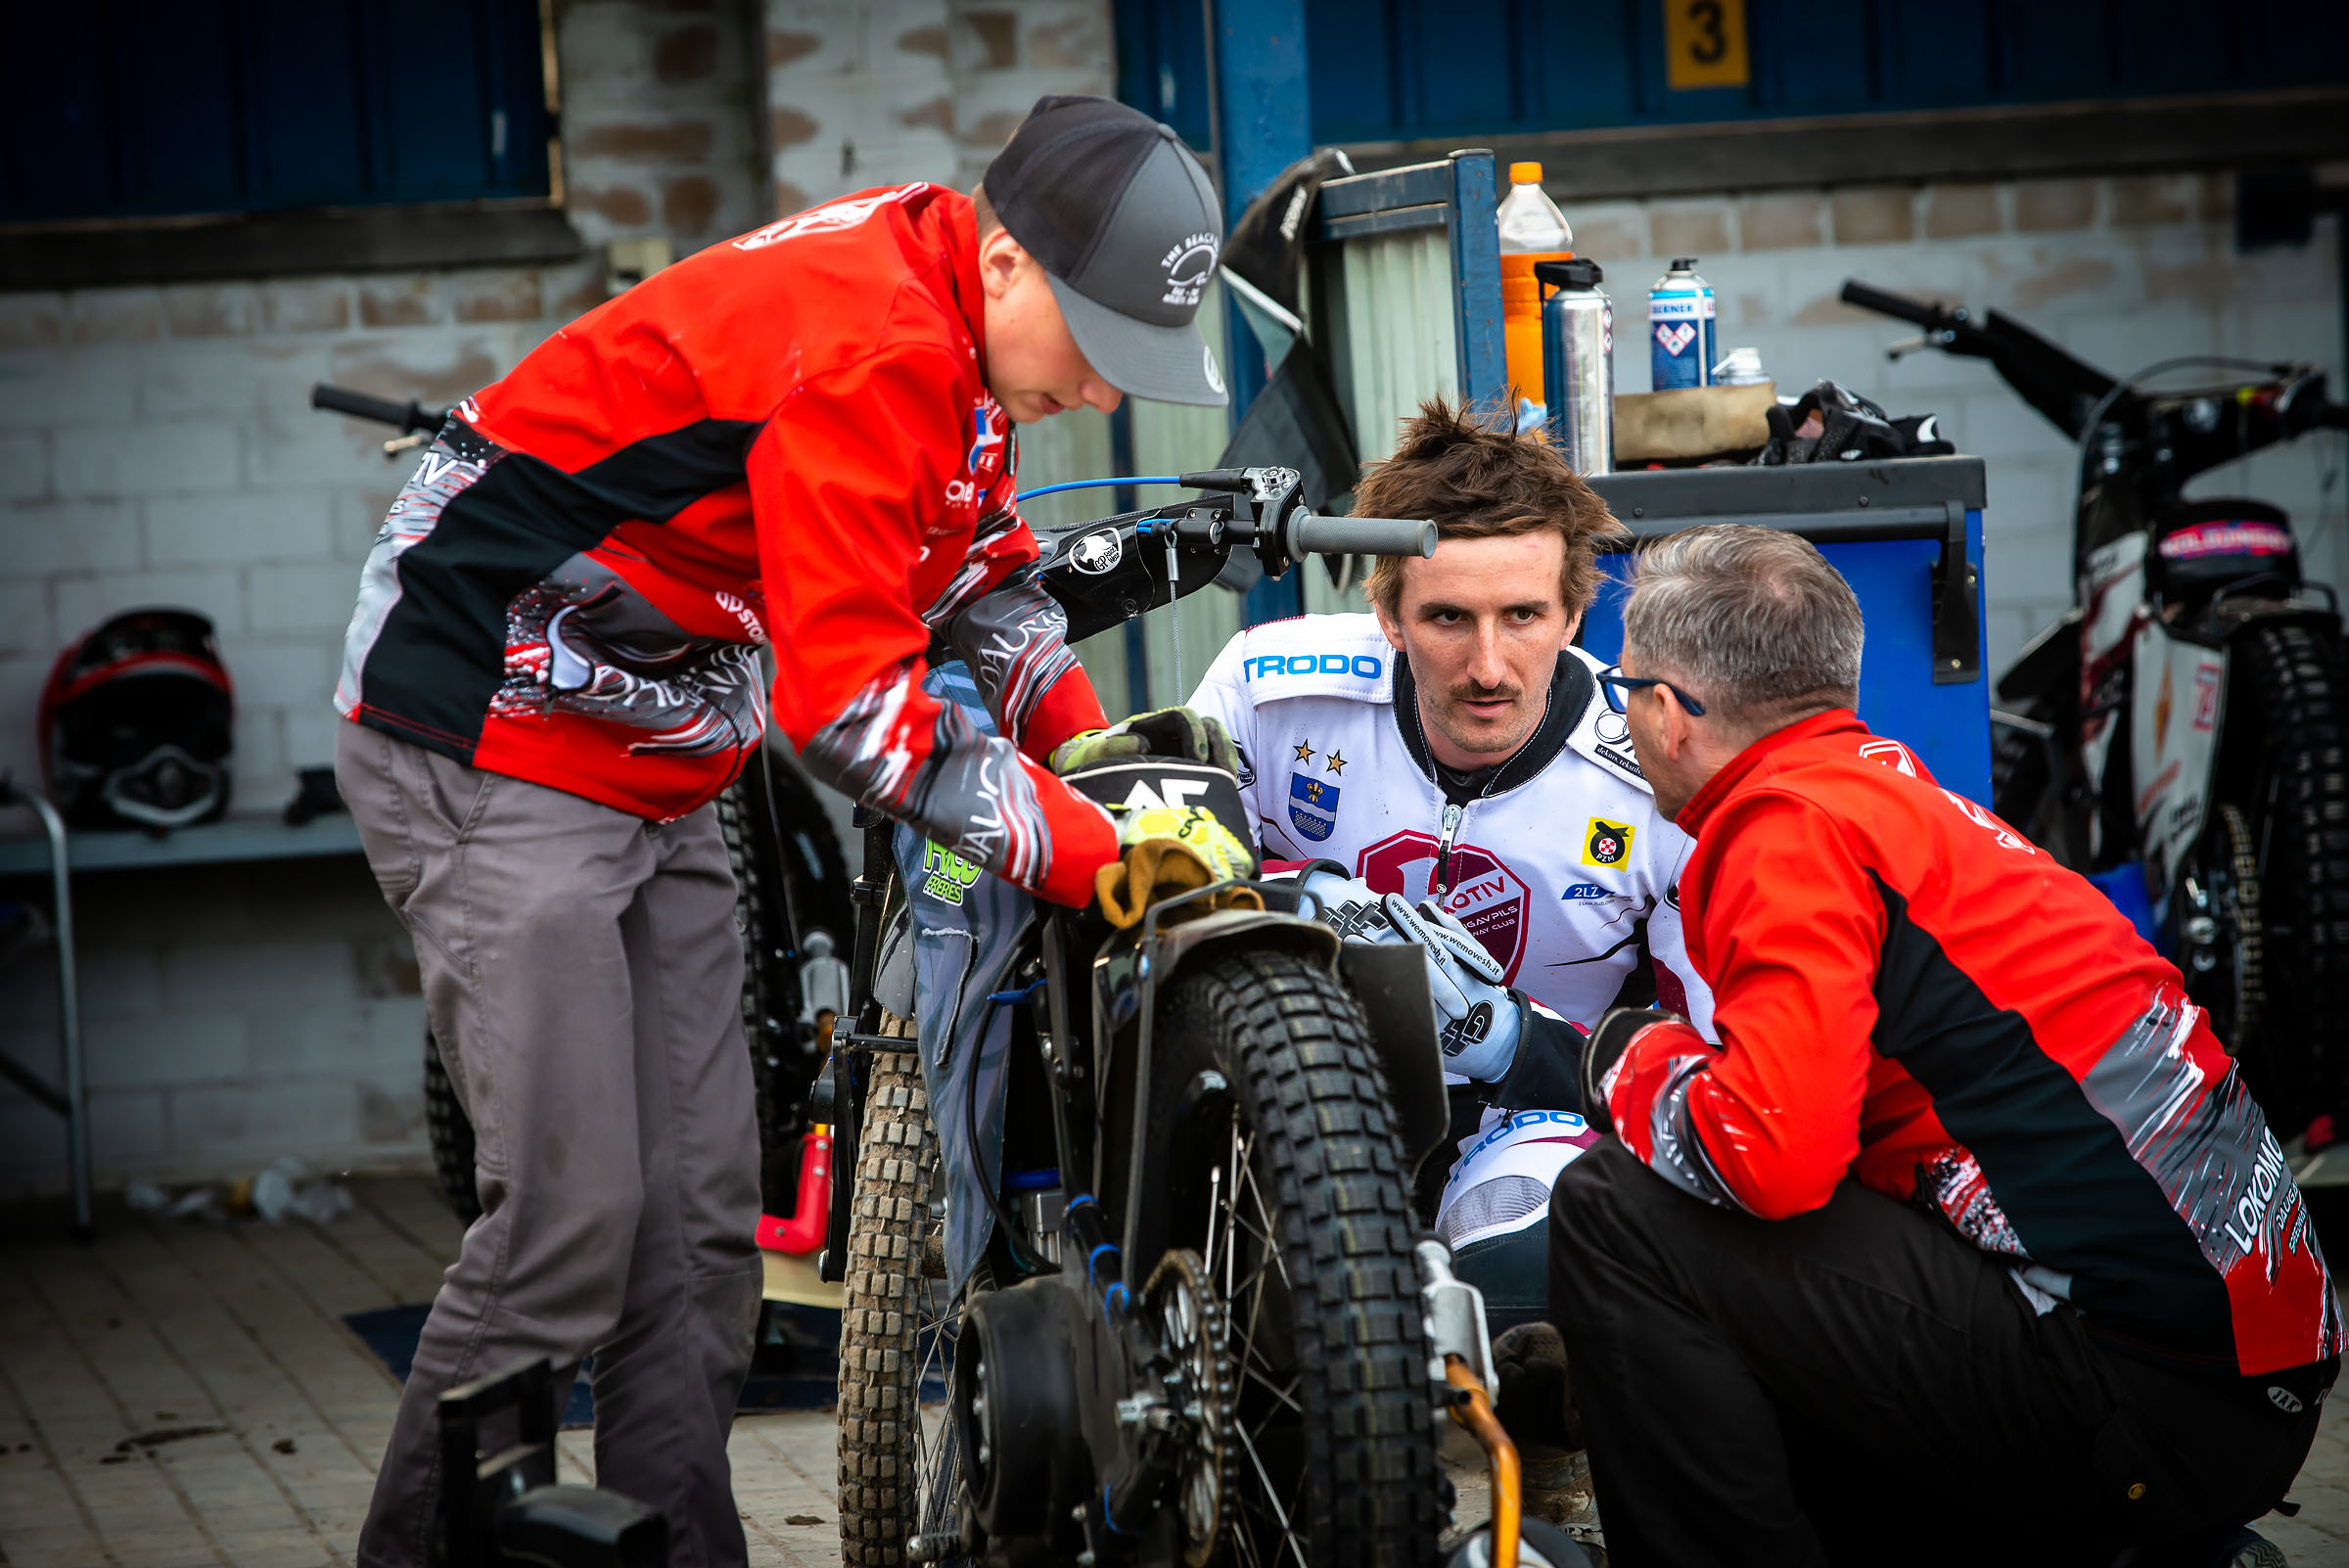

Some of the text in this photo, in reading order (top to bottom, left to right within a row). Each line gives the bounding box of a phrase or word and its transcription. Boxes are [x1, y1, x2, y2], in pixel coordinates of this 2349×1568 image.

[1687, 0, 1728, 65] 3
[1244, 654, 1381, 683] TRODO
[1596, 853, 1615, 862] PZM
[1442, 875, 1505, 914] OTIV
[1391, 899, 1447, 966] www.wemovesh.it
[1492, 918, 1516, 931] CLUB
[1433, 929, 1500, 976] ww.wemovesh.it
